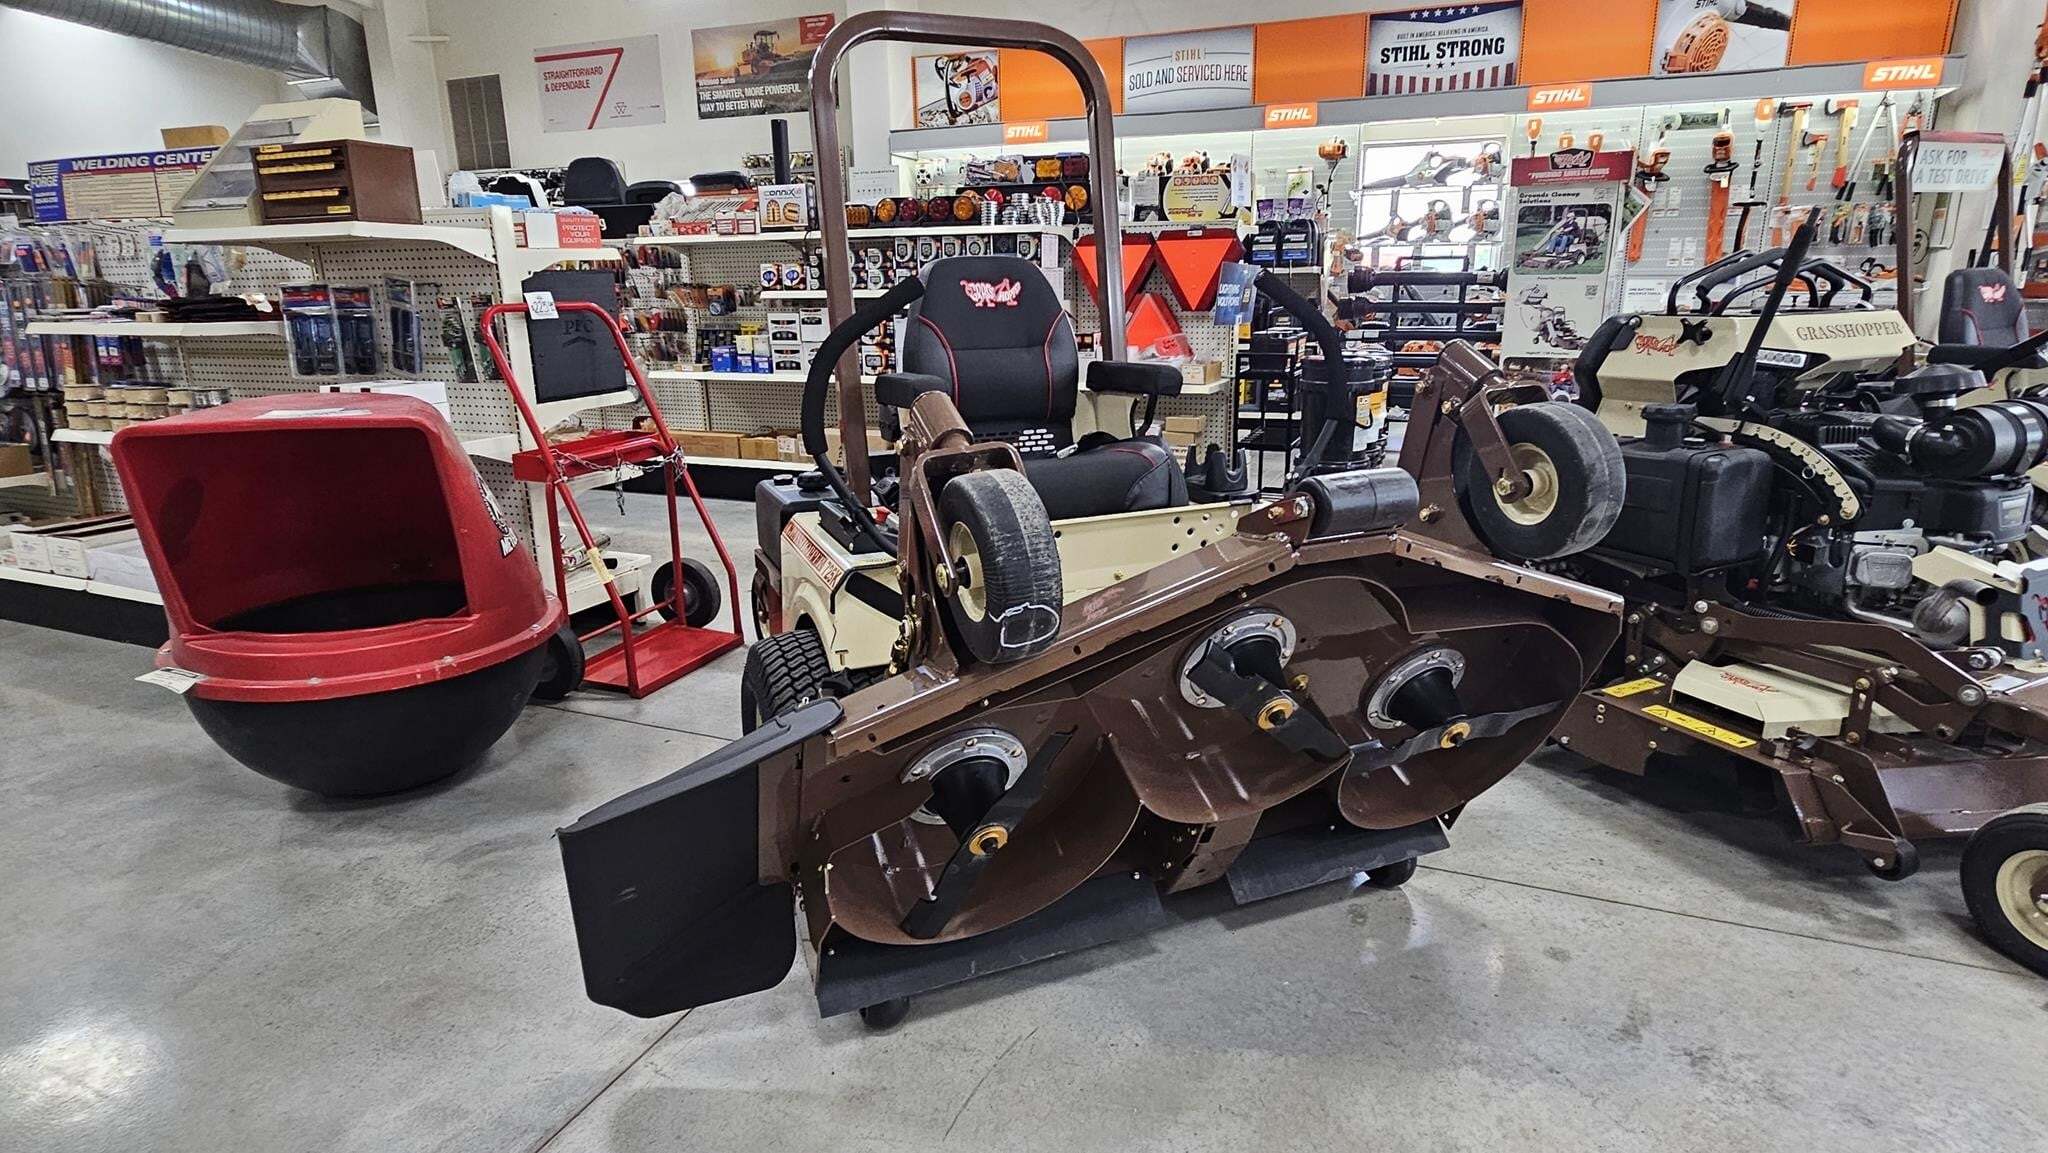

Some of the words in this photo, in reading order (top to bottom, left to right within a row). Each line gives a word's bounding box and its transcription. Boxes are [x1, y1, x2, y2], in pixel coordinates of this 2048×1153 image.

[1175, 48, 1201, 61] STIHL
[1380, 45, 1430, 64] STIHL
[1436, 37, 1505, 59] STRONG
[543, 66, 604, 80] STRAIGHTFORWARD
[1129, 71, 1153, 91] SOLD
[1155, 67, 1175, 86] AND
[1177, 64, 1222, 83] SERVICED
[1224, 64, 1248, 82] HERE
[1870, 64, 1936, 82] STIHL
[544, 83, 550, 92] &
[551, 79, 590, 92] DEPENDABLE
[699, 91, 712, 100] THE
[712, 88, 745, 100] SMARTER,
[745, 86, 764, 97] MORE
[765, 83, 801, 95] POWERFUL
[1532, 87, 1585, 105] STIHL
[700, 102, 716, 112] WAY
[716, 101, 725, 111] TO
[725, 100, 749, 110] BETTER
[750, 98, 766, 108] HAY.
[1267, 107, 1312, 122] STIHL
[1007, 125, 1042, 138] STIHL
[72, 156, 149, 171] WELDING
[1919, 149, 1944, 165] ASK
[1946, 150, 1968, 165] FOR
[1914, 169, 1923, 183] A
[1927, 169, 1953, 184] TEST
[1955, 169, 1989, 184] DRIVE
[1796, 320, 1903, 341] GRASSHOPPER
